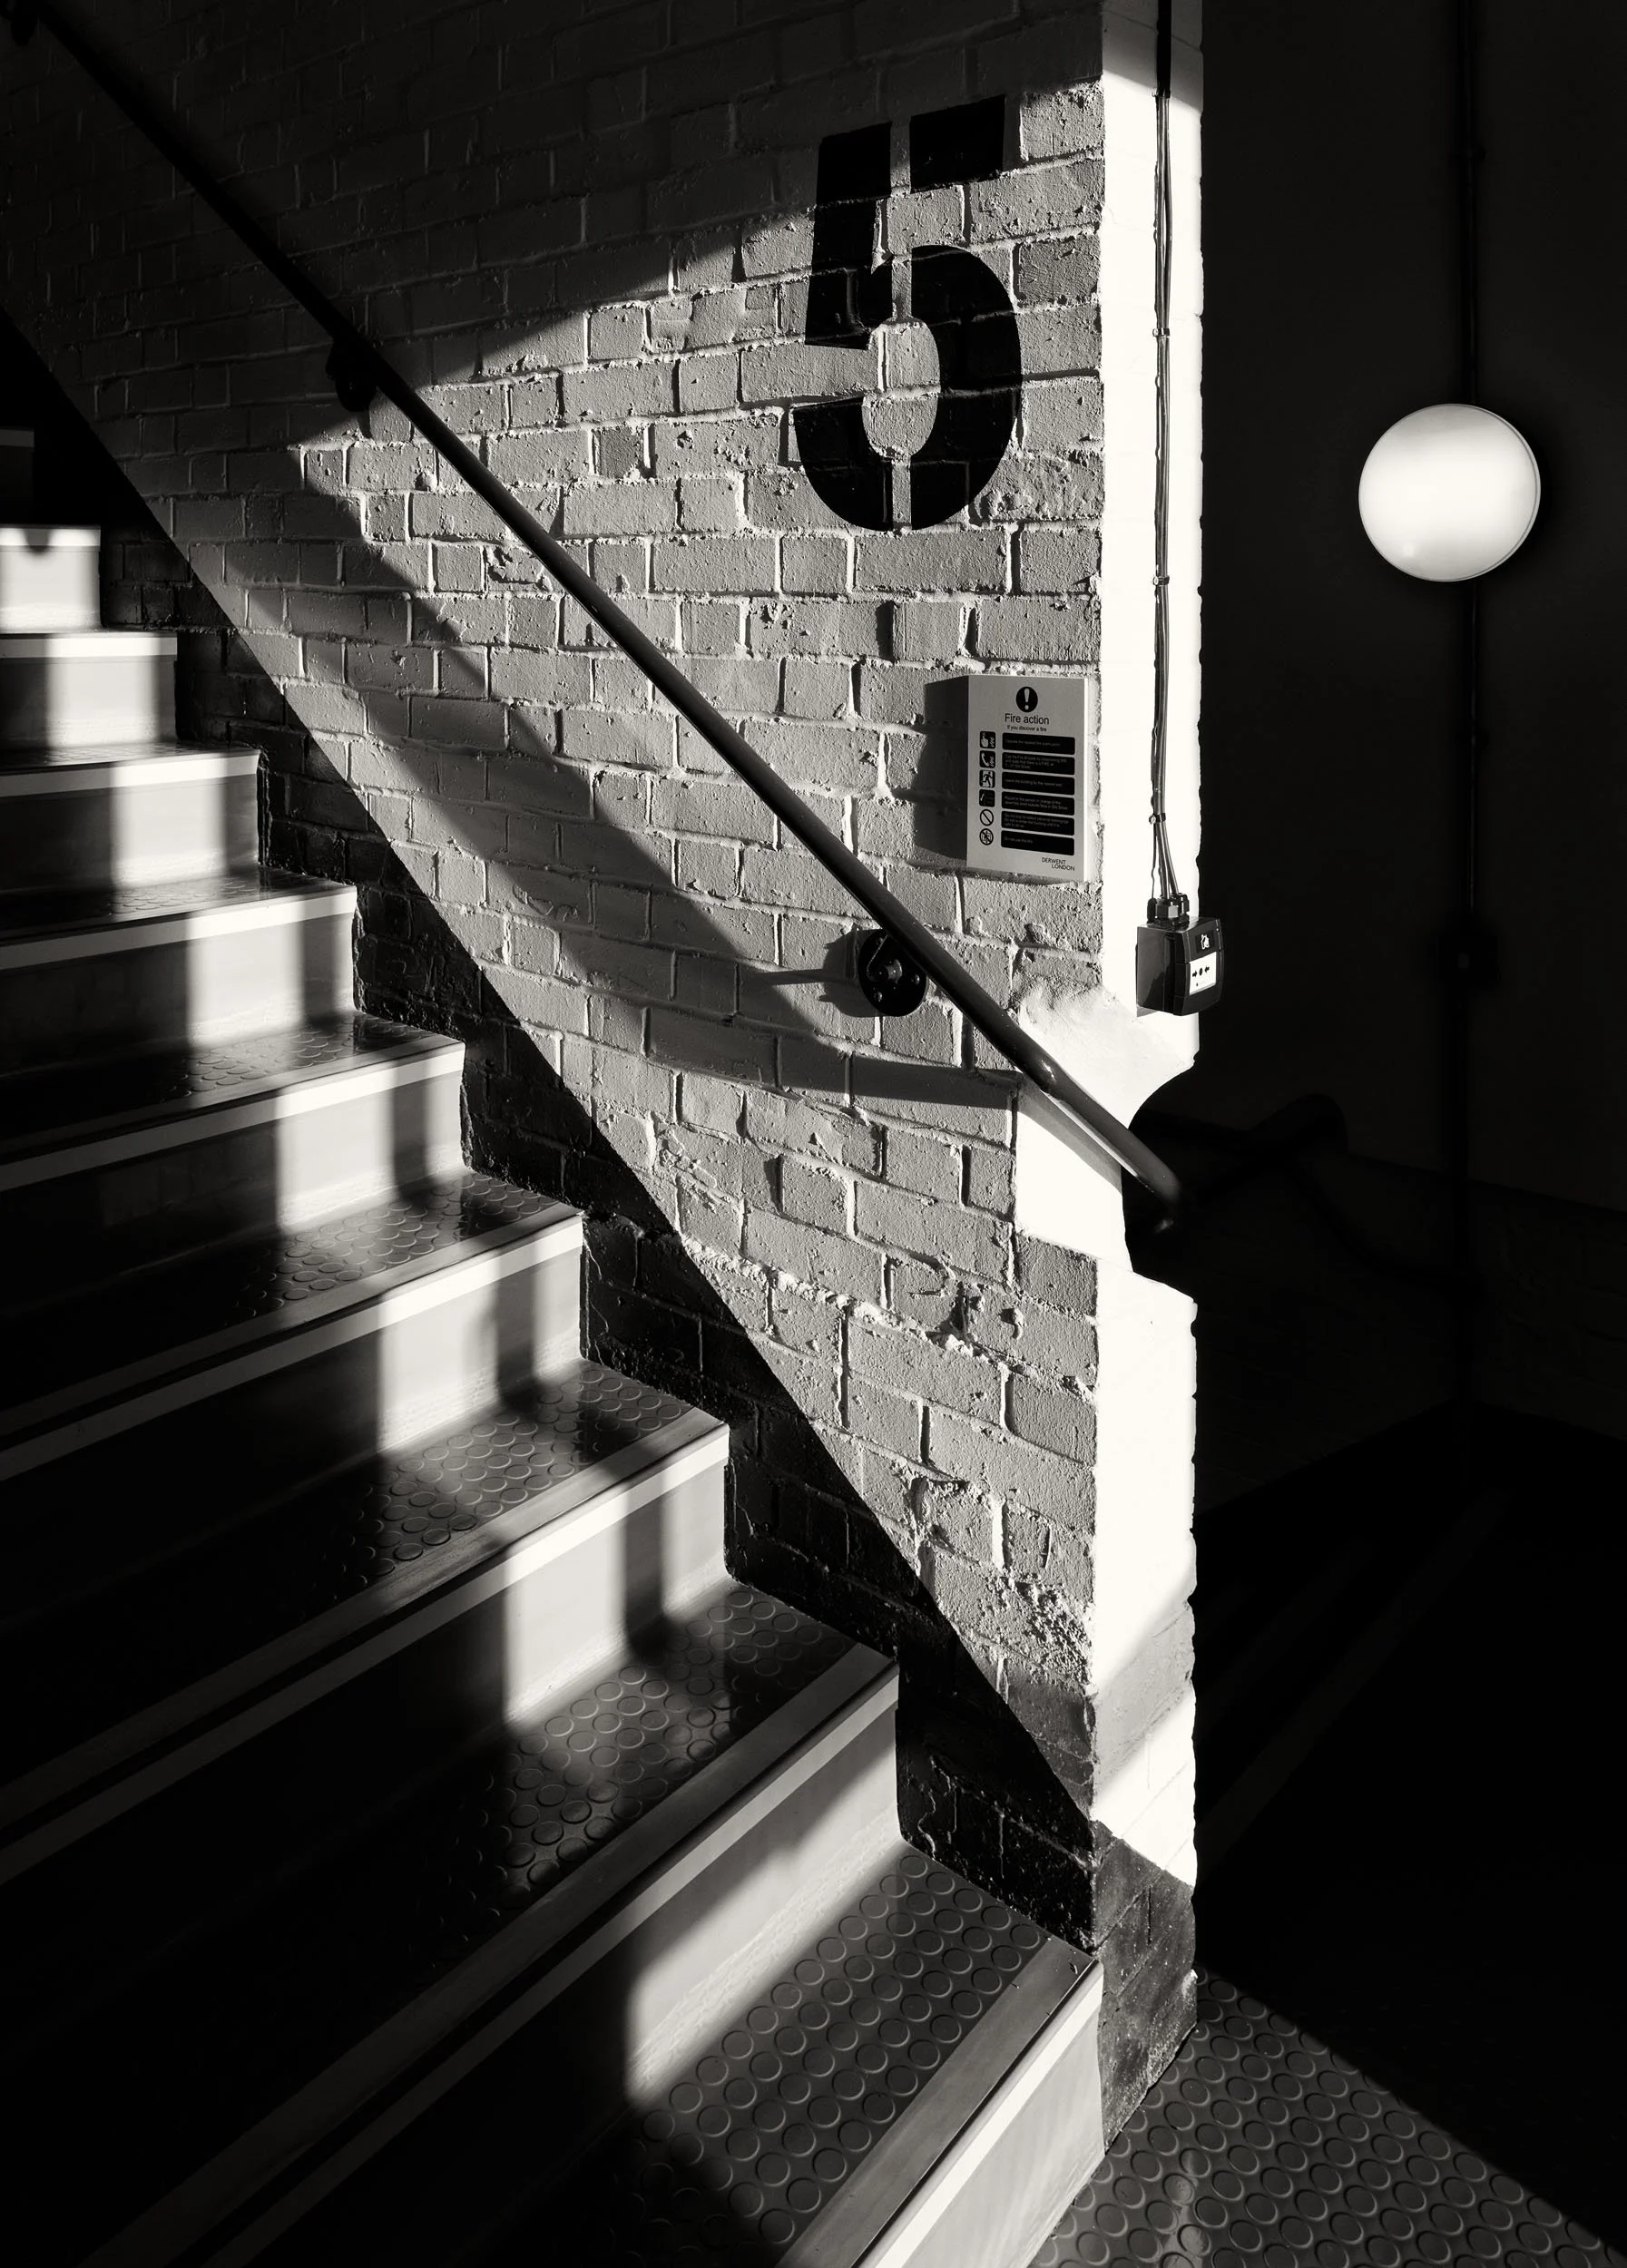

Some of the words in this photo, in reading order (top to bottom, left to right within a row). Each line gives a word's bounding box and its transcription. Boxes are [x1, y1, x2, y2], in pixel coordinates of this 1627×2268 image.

[792, 94, 1023, 531] 5
[1005, 713, 1021, 723] Fire
[1024, 715, 1050, 725] action
